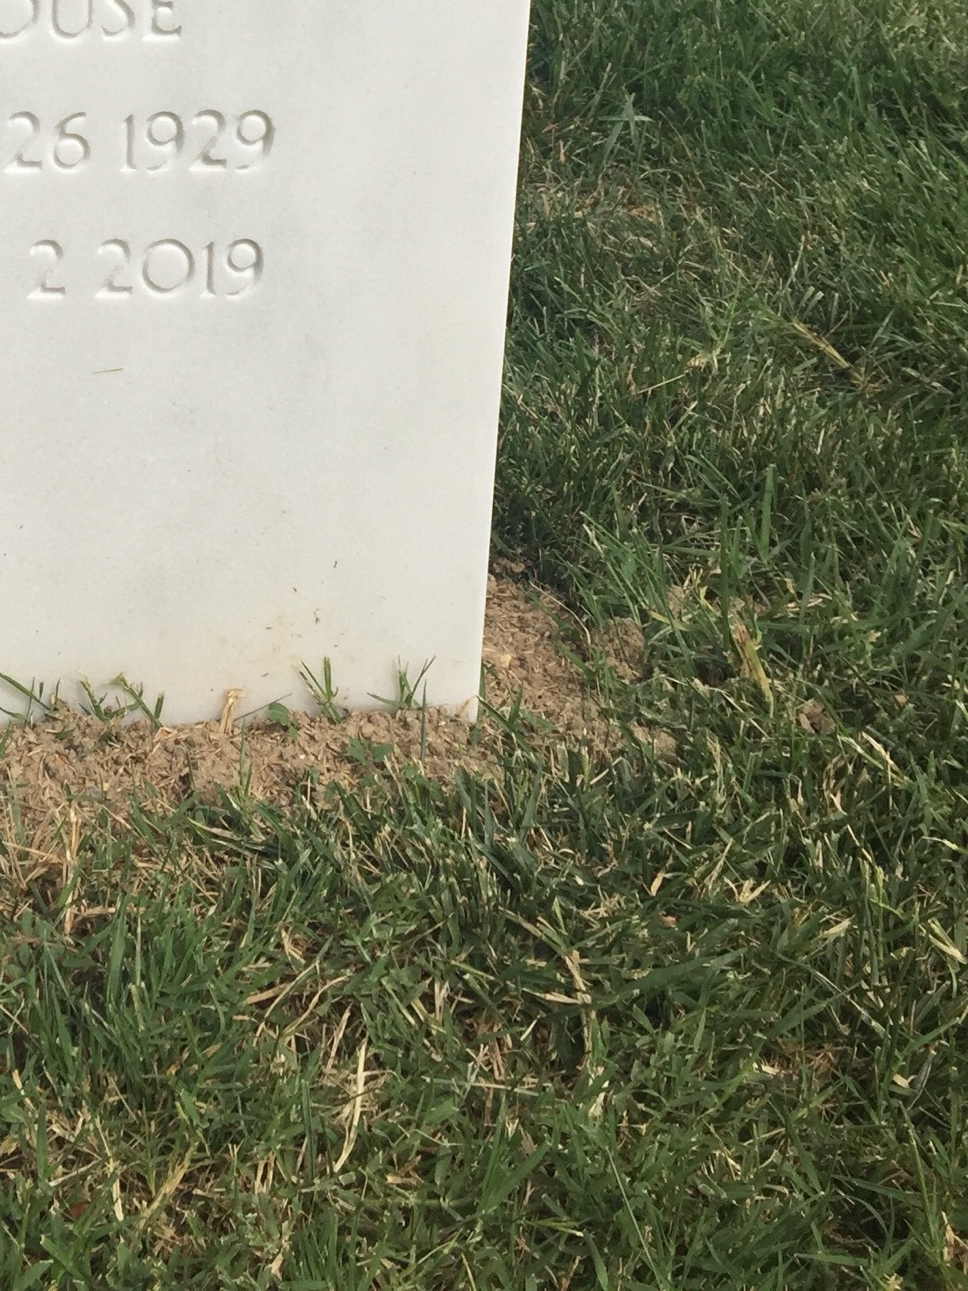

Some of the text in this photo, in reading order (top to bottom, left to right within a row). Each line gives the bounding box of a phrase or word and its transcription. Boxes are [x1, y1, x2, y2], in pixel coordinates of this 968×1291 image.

[4, 111, 90, 175] 26
[120, 109, 275, 174] 1929
[26, 238, 66, 299] 2
[94, 238, 264, 298] 2019
